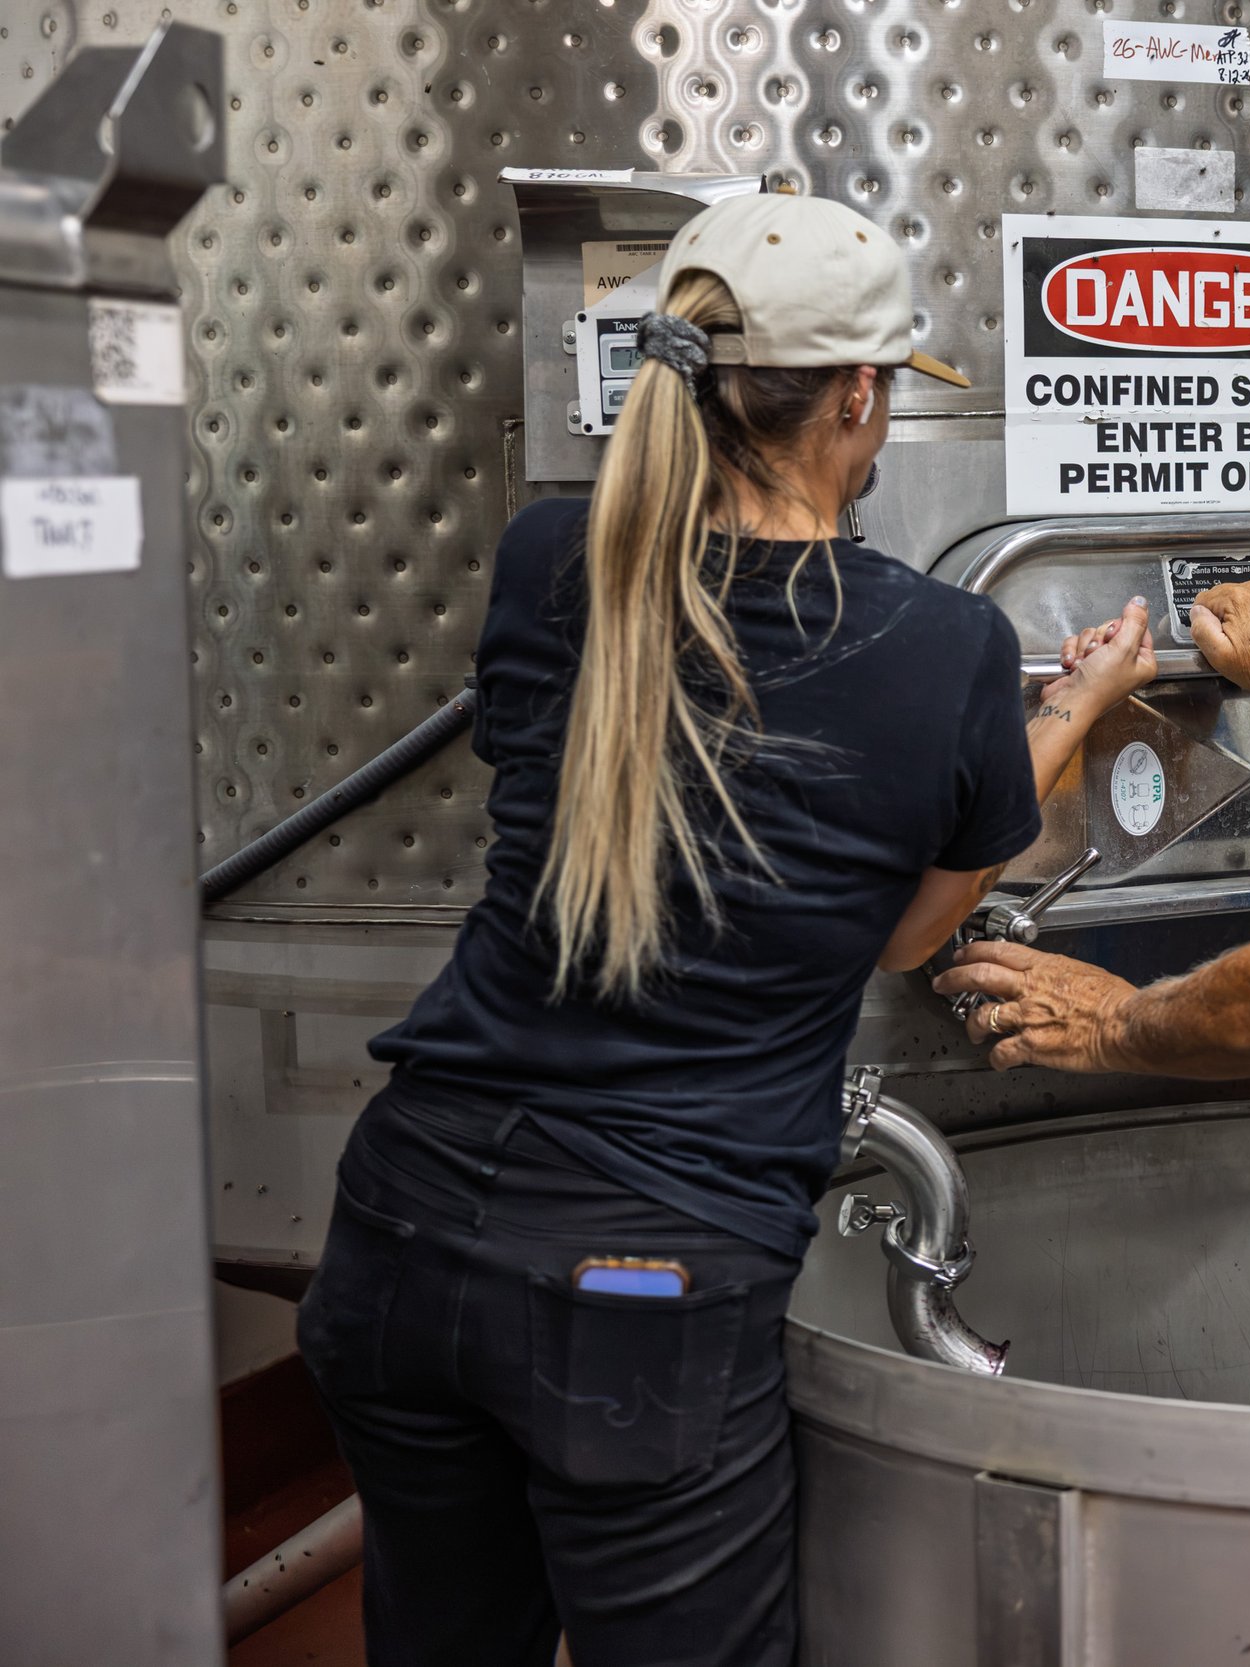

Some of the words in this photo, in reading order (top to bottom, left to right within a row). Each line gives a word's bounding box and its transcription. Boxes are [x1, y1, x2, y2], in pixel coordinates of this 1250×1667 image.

[1026, 374, 1220, 407] CONFINED
[1096, 422, 1223, 453] ENTER
[1059, 462, 1209, 494] PERMIT
[1191, 567, 1211, 575] Santa
[1212, 566, 1230, 574] Rosa
